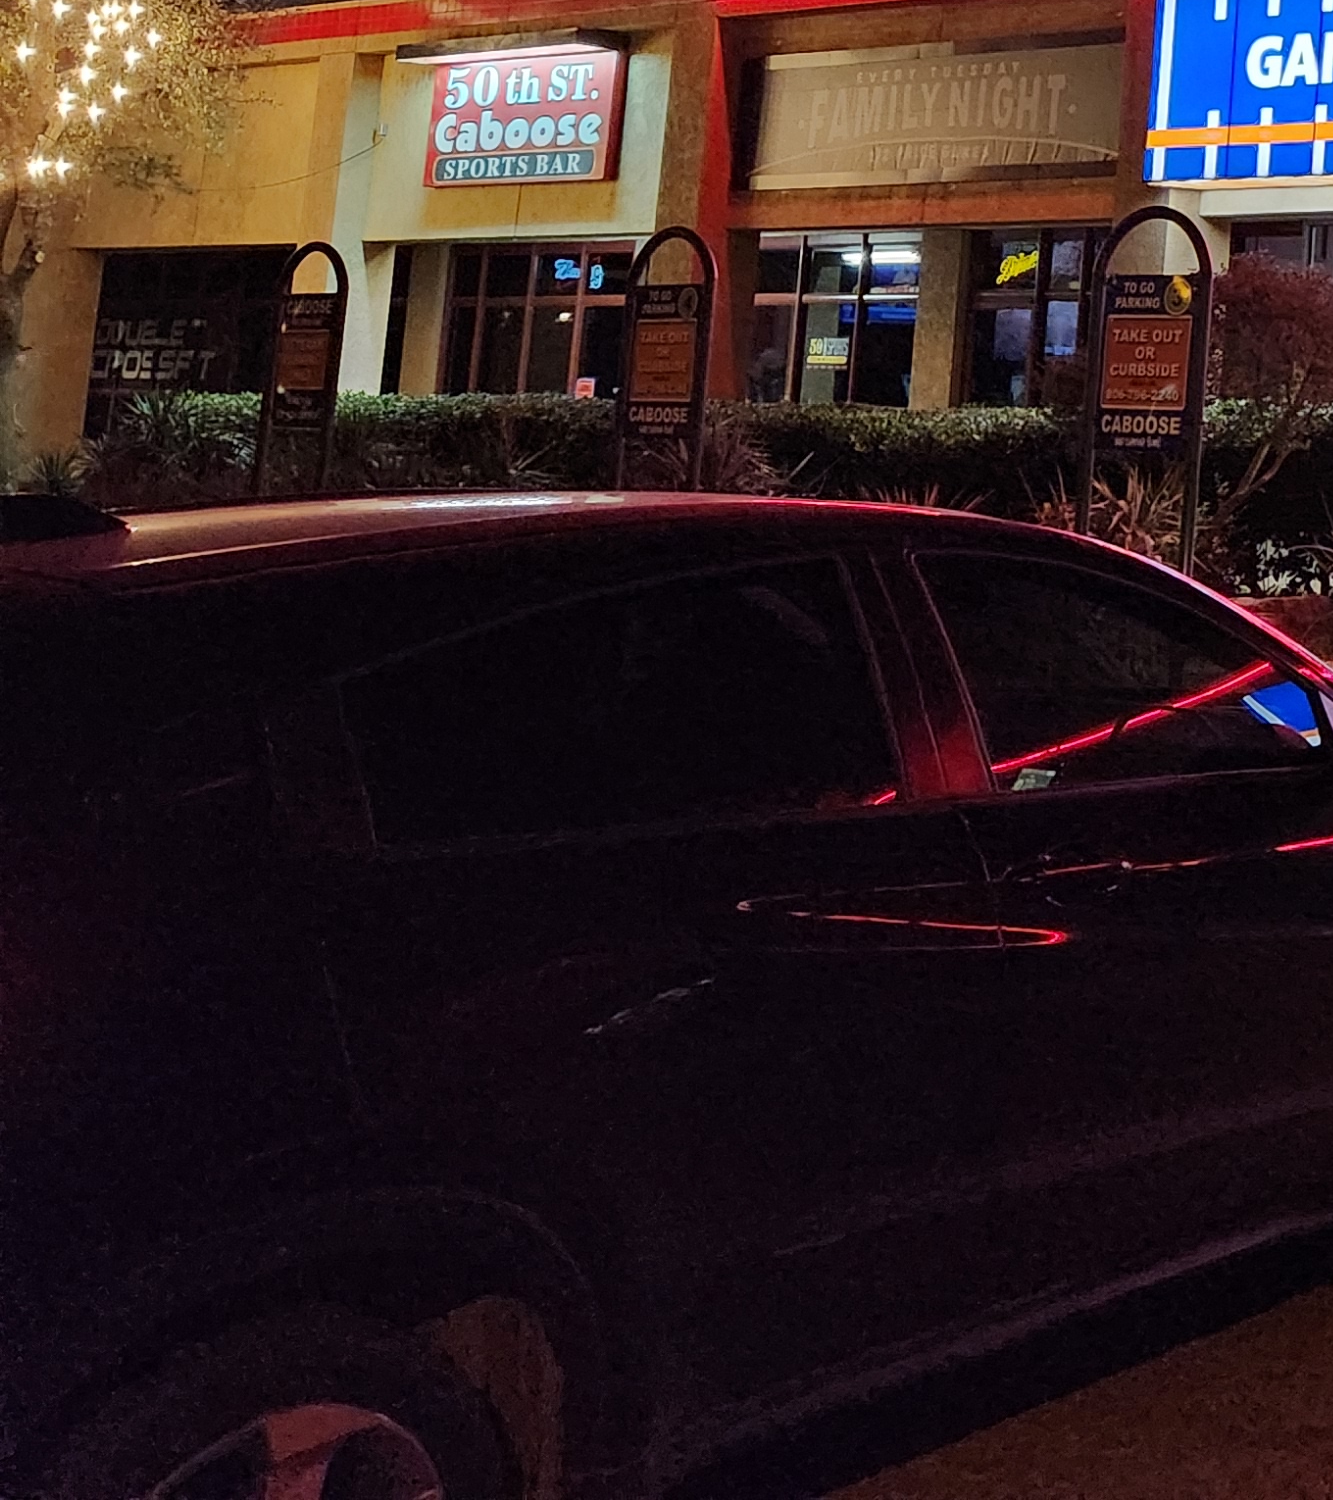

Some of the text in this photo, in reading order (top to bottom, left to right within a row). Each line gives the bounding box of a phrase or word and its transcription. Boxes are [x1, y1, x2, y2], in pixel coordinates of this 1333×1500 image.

[547, 63, 600, 102] ST.
[856, 61, 1021, 84] EVERY TUESDAY
[807, 74, 1066, 149] FAMILY NIGHT
[434, 109, 603, 154] Caboose
[443, 153, 581, 180] SPORTS BAR
[1124, 282, 1155, 293] TO GO
[1115, 297, 1160, 309] PARKING
[1113, 329, 1183, 344] TAKE OUT
[1135, 347, 1155, 360] OR
[1110, 364, 1180, 377] CURBSIDE
[629, 406, 689, 424] CABOOSE
[1101, 414, 1181, 436] CABOOSE
